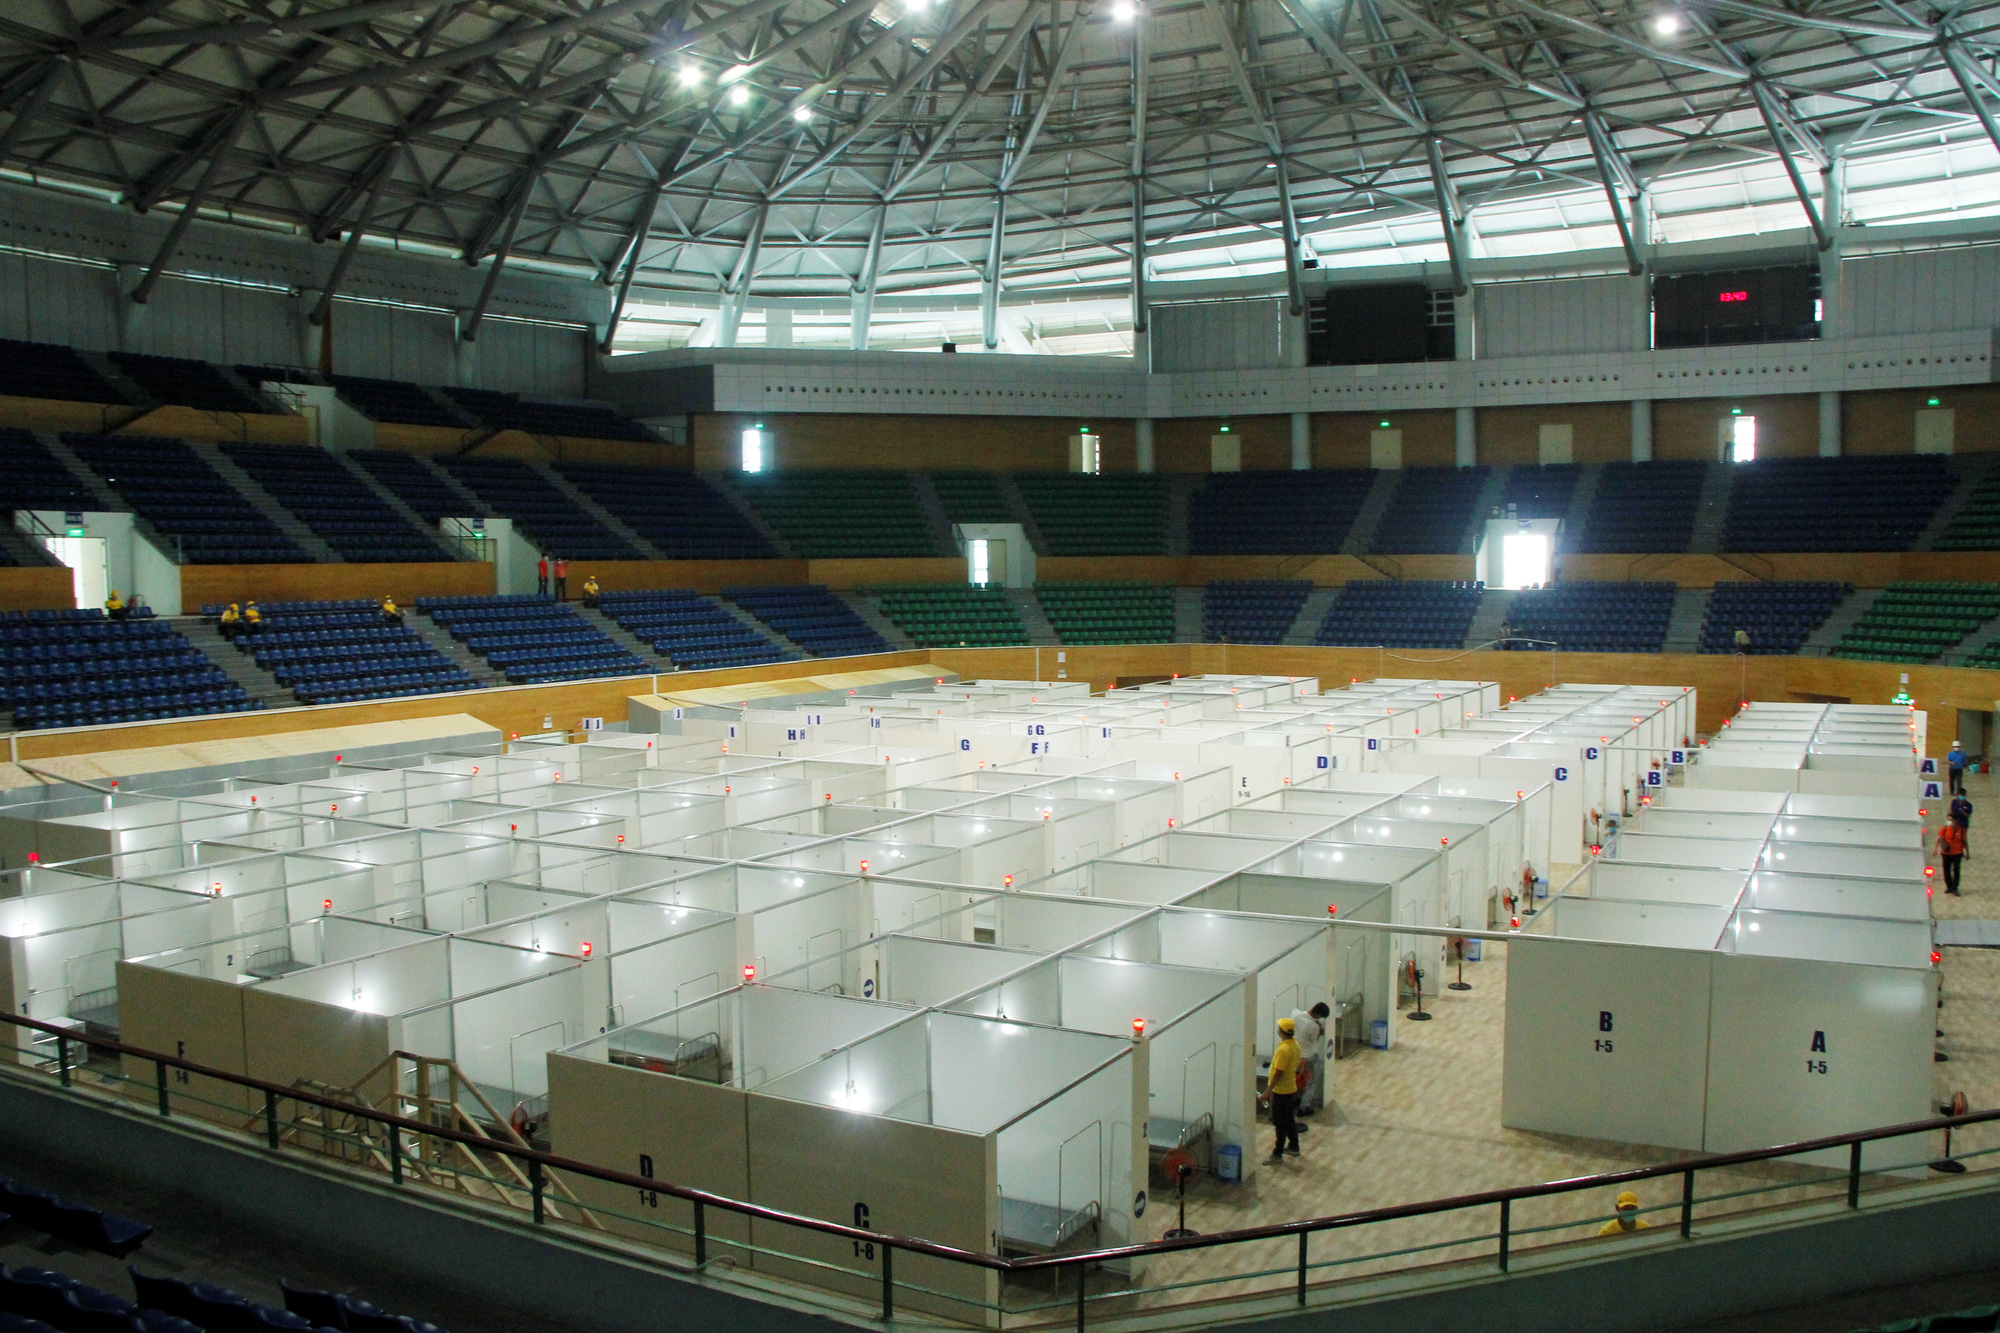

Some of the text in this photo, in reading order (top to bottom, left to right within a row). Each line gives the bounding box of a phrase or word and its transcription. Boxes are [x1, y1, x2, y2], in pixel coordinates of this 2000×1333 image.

[788, 730, 796, 740] H
[1036, 725, 1045, 735] G
[961, 739, 970, 751] G
[1031, 742, 1039, 754] F
[1368, 738, 1377, 750] D
[1586, 747, 1598, 760] C
[1672, 751, 1684, 763] B
[1317, 756, 1328, 768] D
[1921, 760, 1935, 773] A
[1555, 767, 1568, 781] C
[1648, 772, 1661, 785] B
[1924, 783, 1940, 798] A
[227, 954, 233, 966] 2
[21, 1002, 28, 1014] 1
[1599, 1010, 1613, 1032] B
[1594, 1039, 1613, 1053] 1-5
[1810, 1030, 1826, 1053] A
[1806, 1060, 1827, 1075] 1-5
[640, 1153, 654, 1179] D
[639, 1189, 658, 1208] 1-8
[854, 1202, 870, 1229] C
[852, 1241, 875, 1261] 1-8
